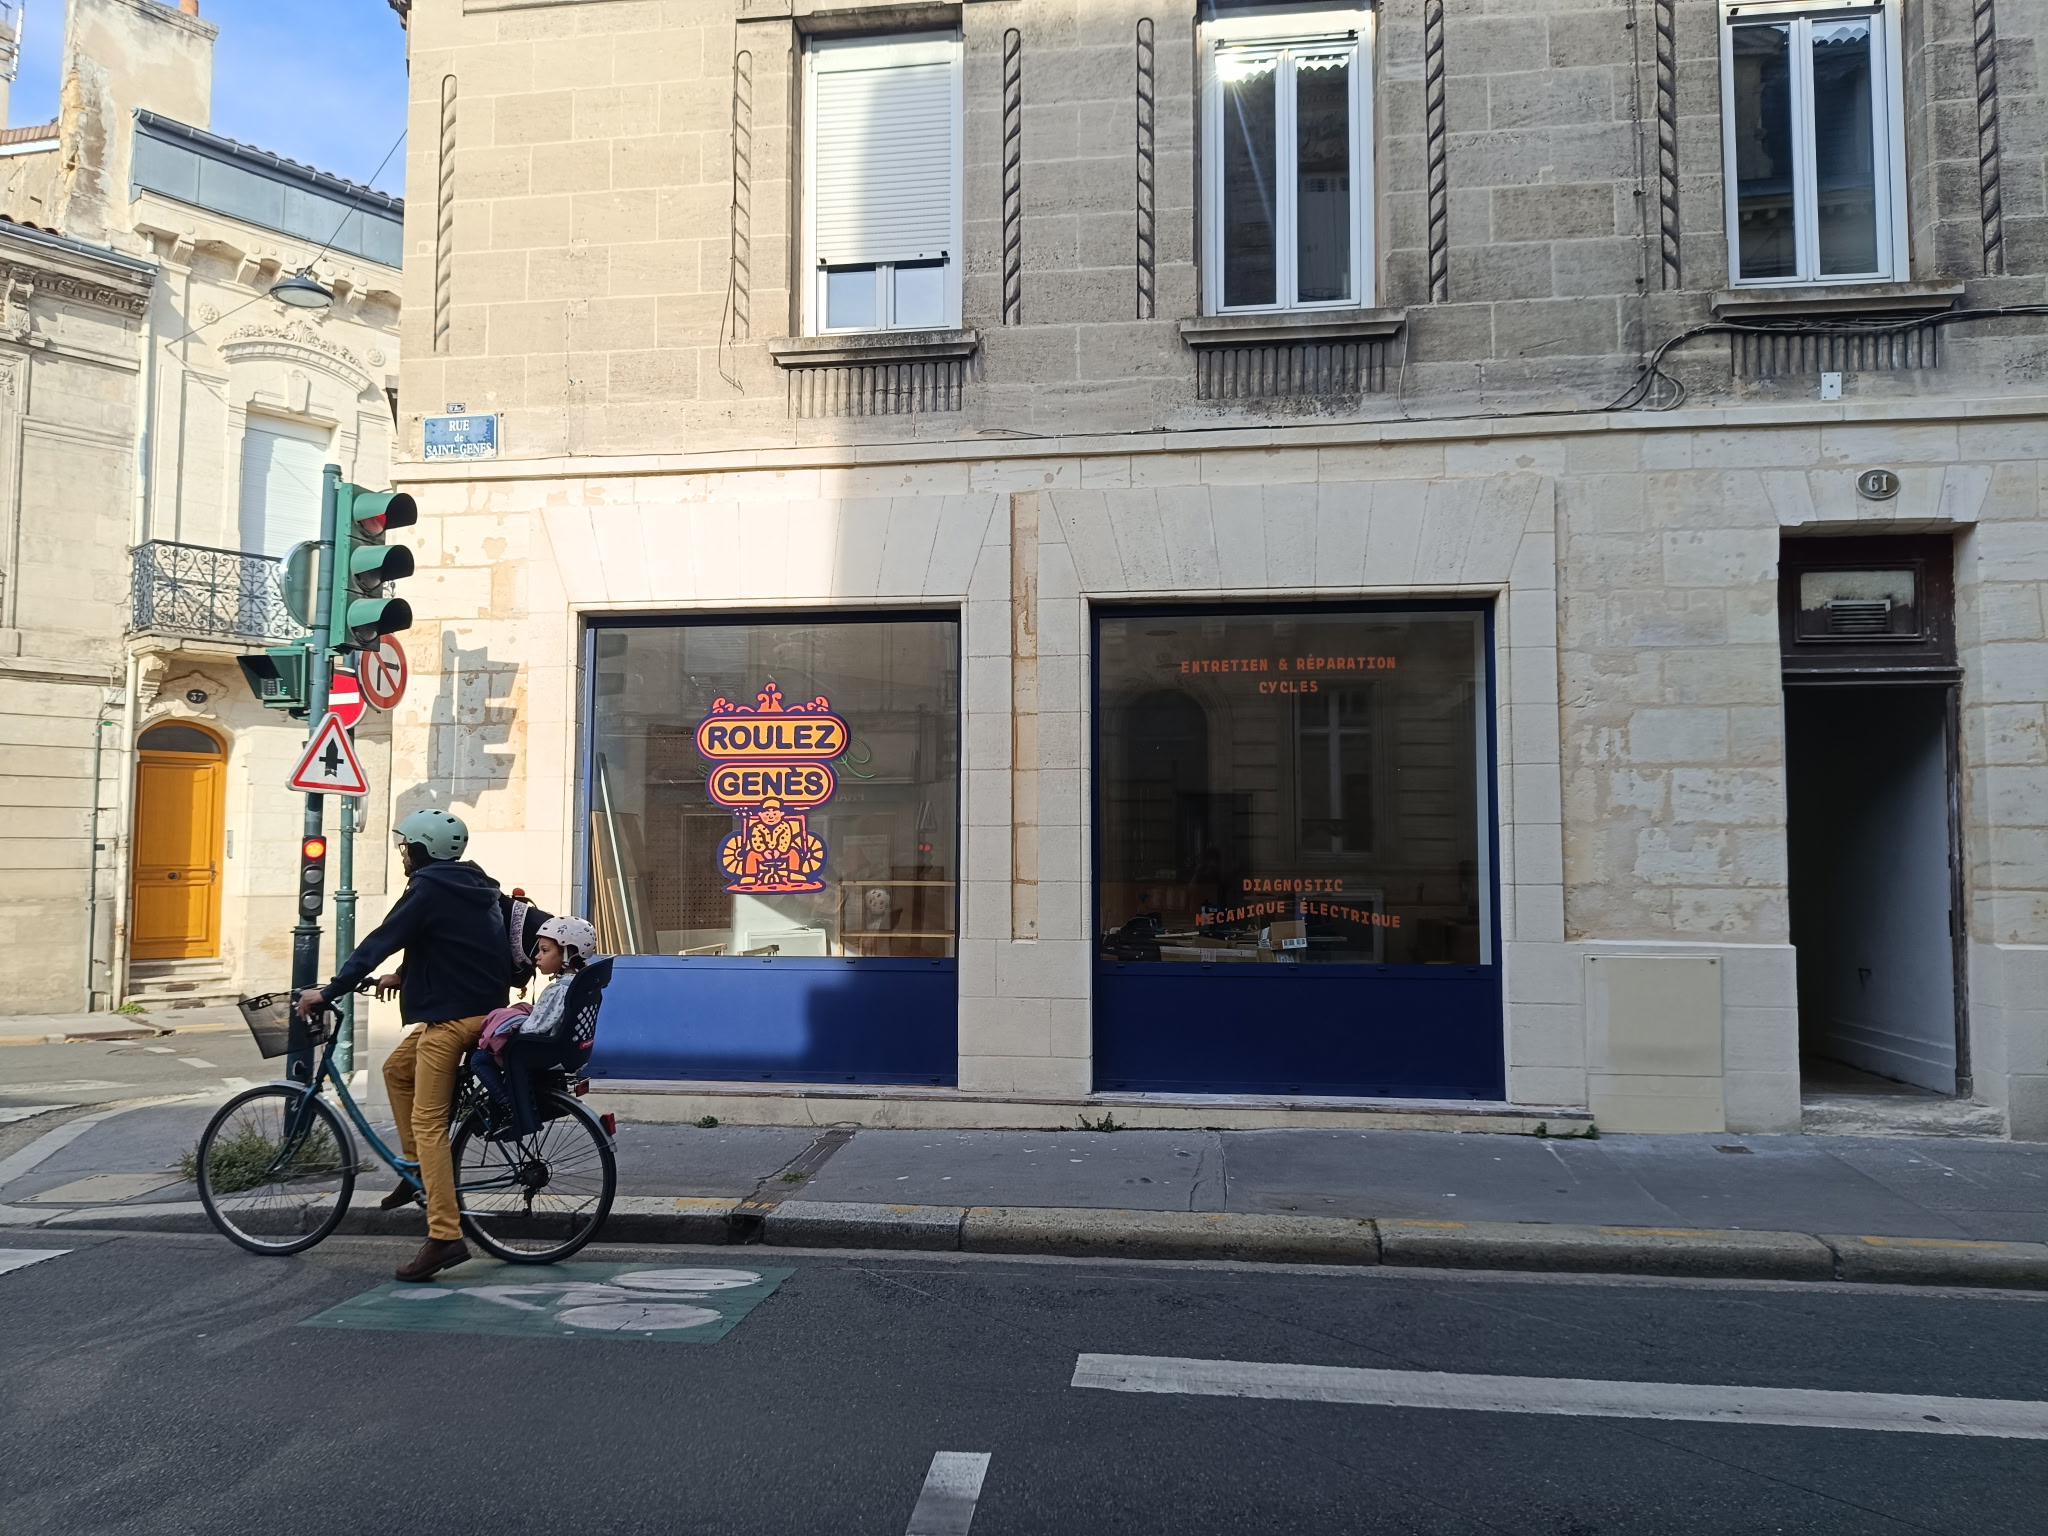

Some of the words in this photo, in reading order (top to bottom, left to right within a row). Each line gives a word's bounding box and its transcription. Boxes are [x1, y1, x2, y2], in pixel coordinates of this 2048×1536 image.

[448, 420, 470, 432] RUE
[454, 433, 464, 442] de
[1868, 474, 1888, 492] 61
[1181, 659, 1268, 673] ENTRETIEN
[1278, 657, 1288, 671] &
[1296, 653, 1396, 671] RÉPARATION
[1259, 680, 1318, 694] CYCLES
[190, 692, 204, 702] 37
[707, 725, 836, 750] ROULEZ
[717, 766, 824, 796] GENÈS
[1243, 879, 1343, 892] DIAGNOSTIC
[1299, 897, 1401, 929] ÉLECTRIQUE
